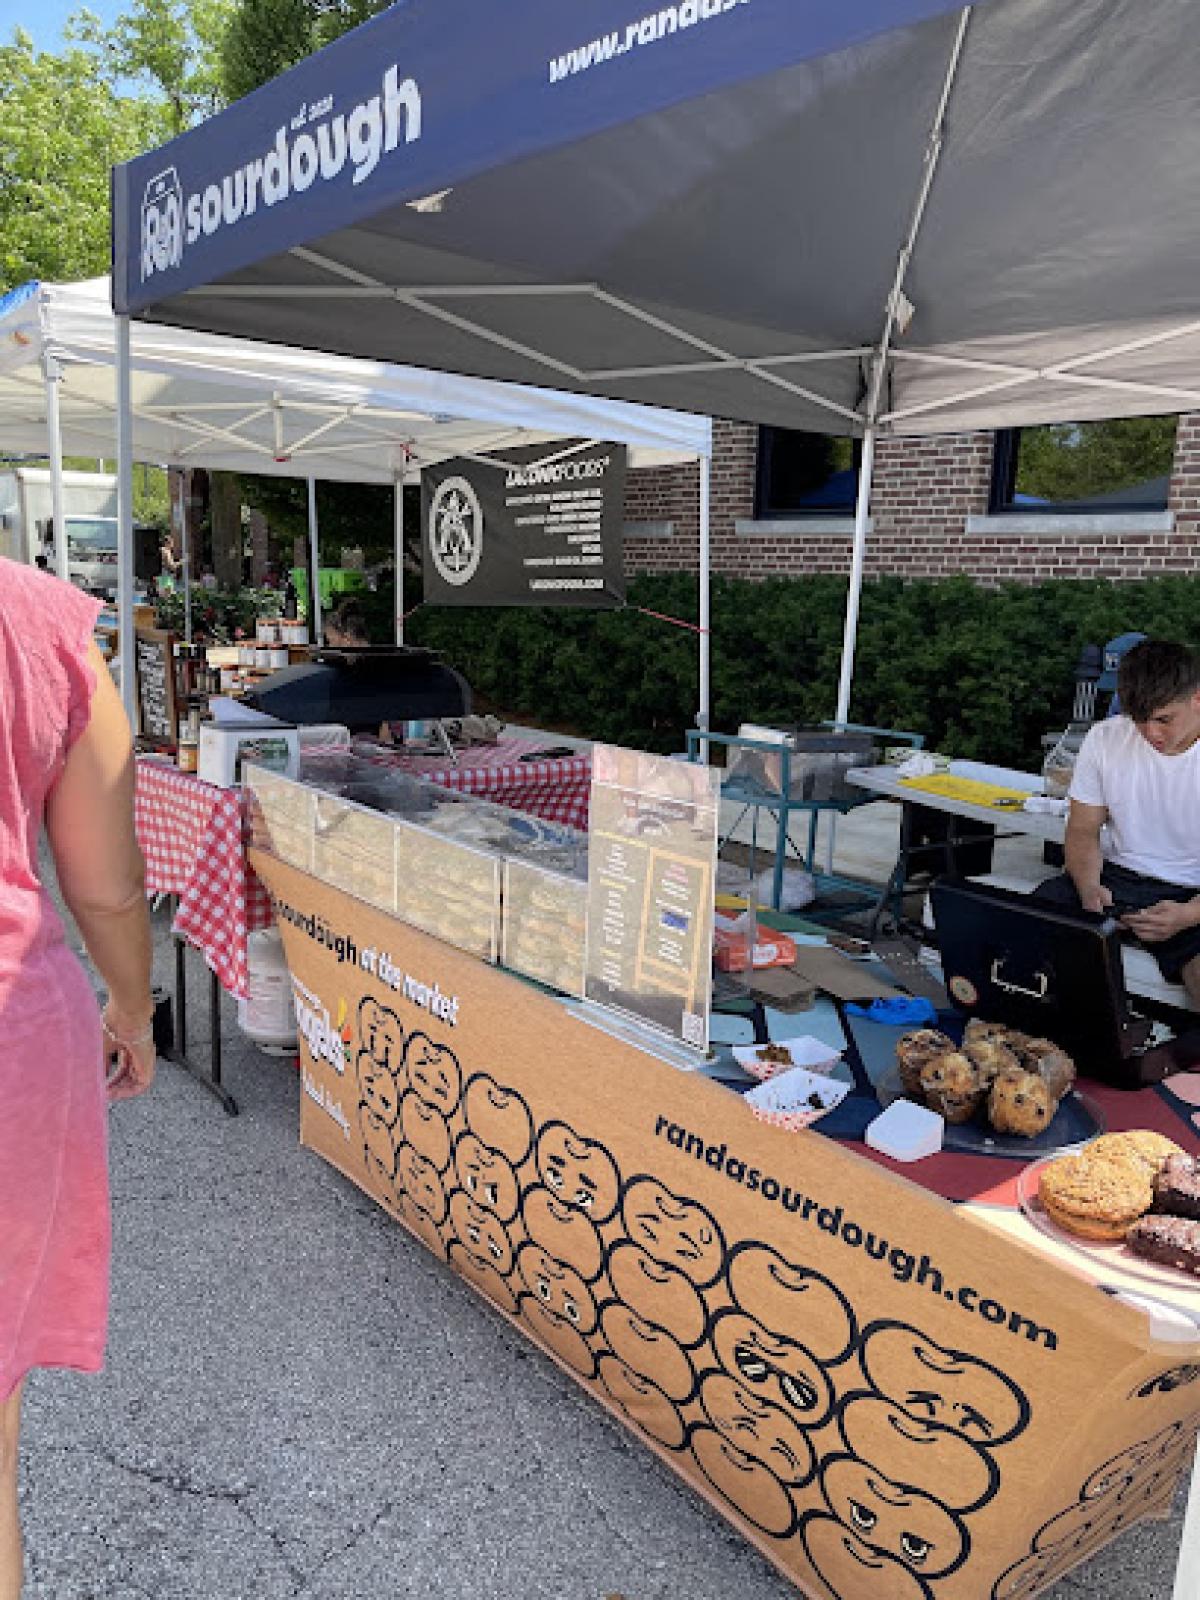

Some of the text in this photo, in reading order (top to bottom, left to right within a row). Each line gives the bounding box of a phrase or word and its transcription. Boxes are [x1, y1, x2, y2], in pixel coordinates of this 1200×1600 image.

[549, 0, 751, 84] www.randa
[185, 64, 422, 244] sourdough
[655, 1115, 1059, 1351] randasourdough.com
